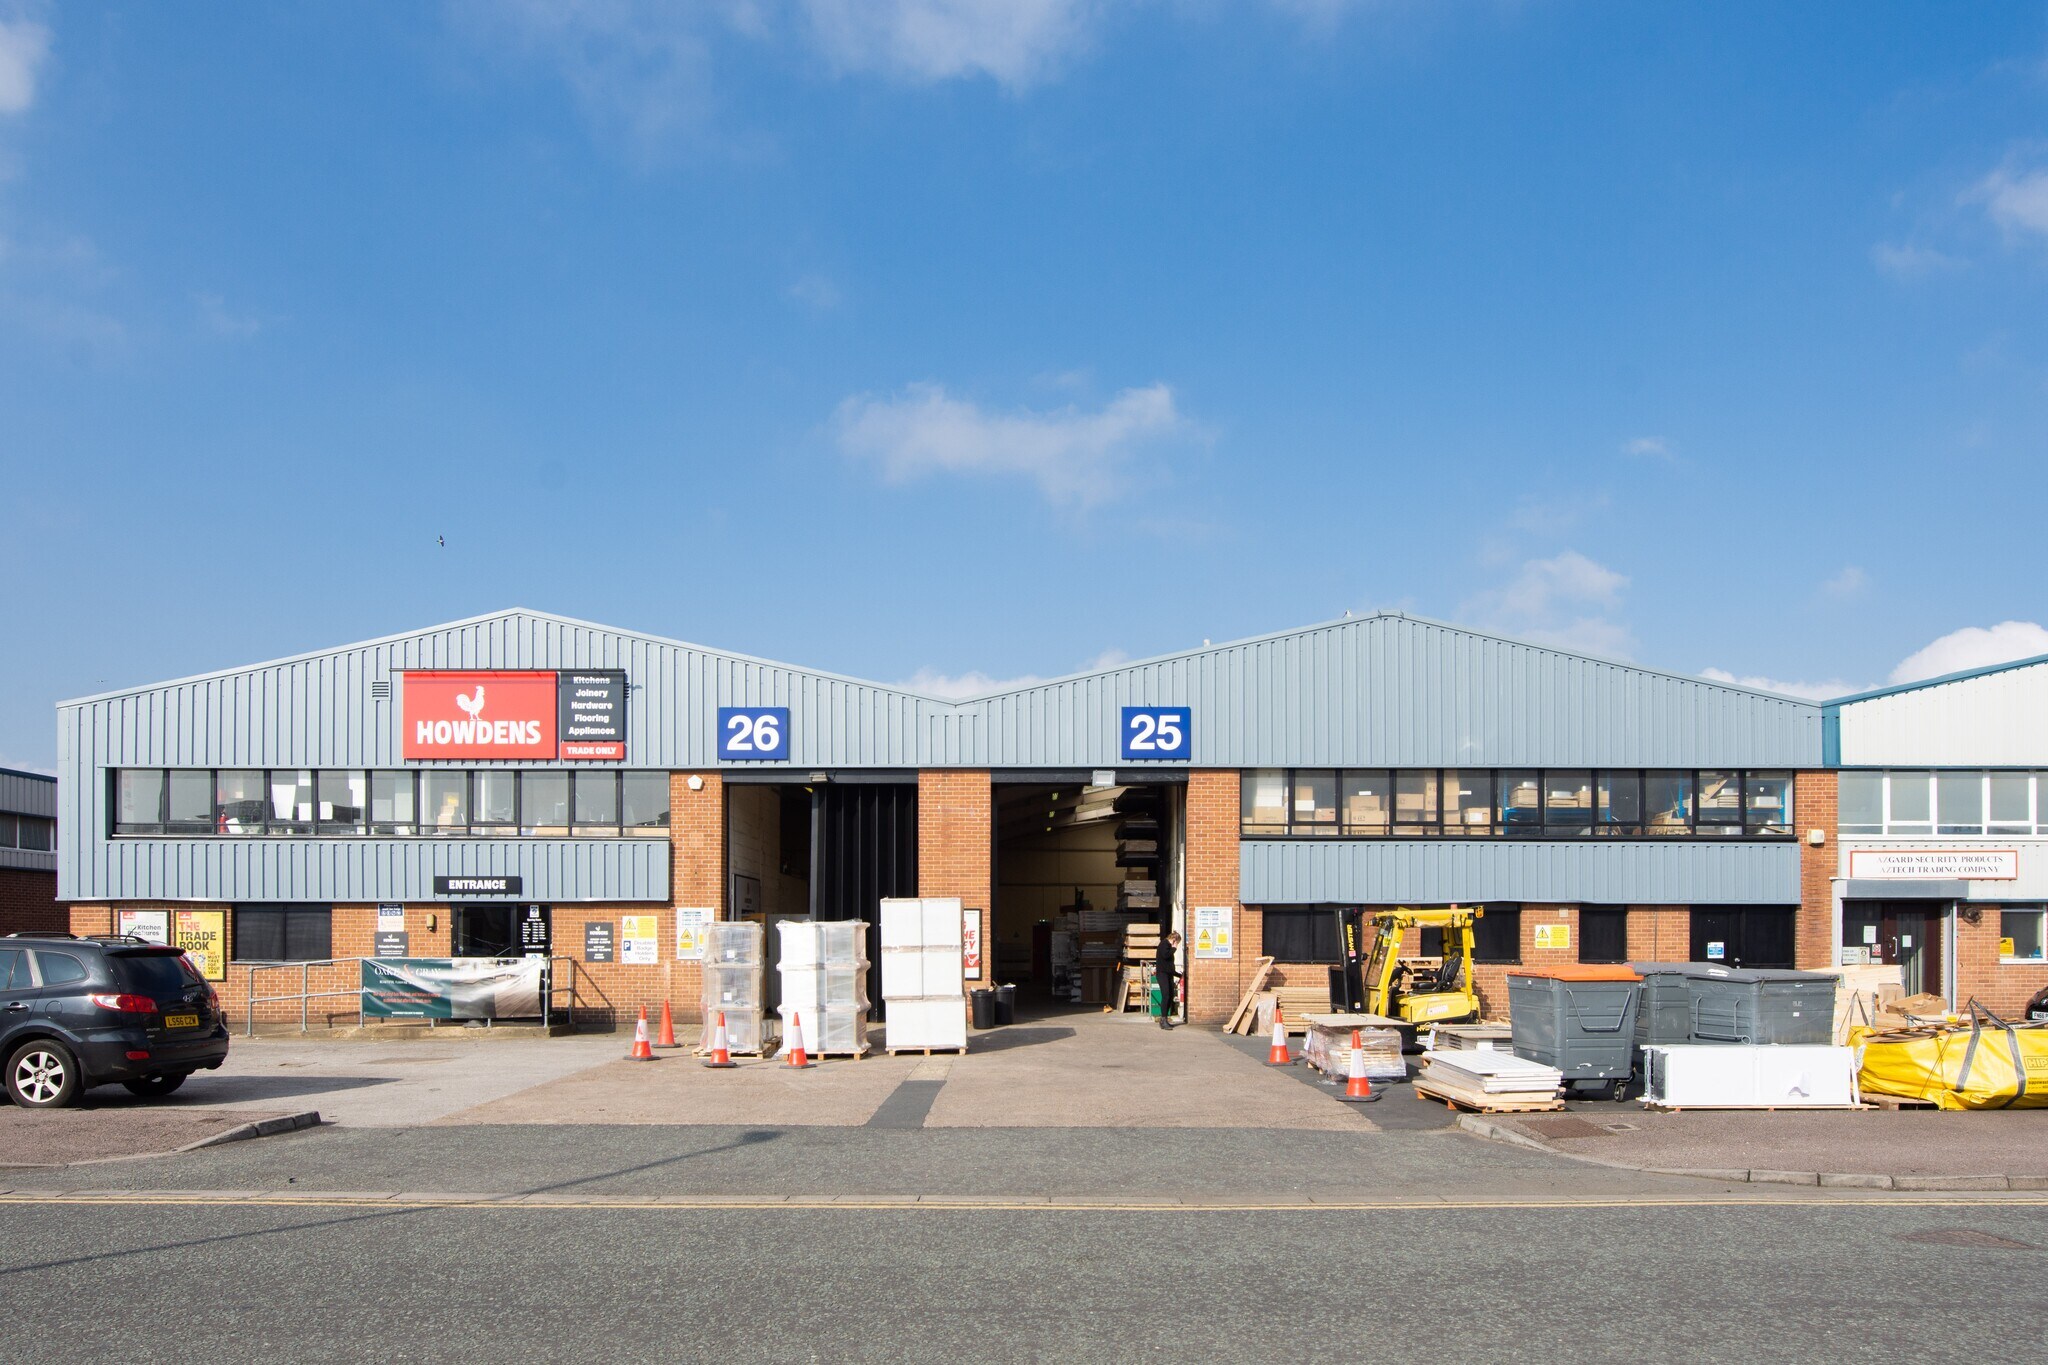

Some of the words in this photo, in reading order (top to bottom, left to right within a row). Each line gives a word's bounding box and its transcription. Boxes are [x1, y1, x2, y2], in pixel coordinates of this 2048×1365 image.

[573, 676, 611, 685] Kitchens
[575, 689, 608, 699] Joinery
[571, 702, 613, 710] Hardware
[574, 714, 610, 724] Flooring
[416, 720, 541, 745] HOWDENS
[568, 727, 616, 736] Appliances
[726, 714, 780, 751] 26
[1129, 714, 1183, 751] 25
[566, 746, 595, 755] TRADE
[596, 746, 617, 755] ONLY
[1961, 855, 2004, 863] PRODUCTS
[1958, 865, 1999, 873] COMPANY
[448, 879, 507, 890] ENTRANCE
[179, 922, 200, 931] THE
[179, 931, 217, 940] TRADE
[1346, 924, 1355, 951] HYSTER
[179, 941, 210, 950] BOOK
[167, 1017, 184, 1026] LS56
